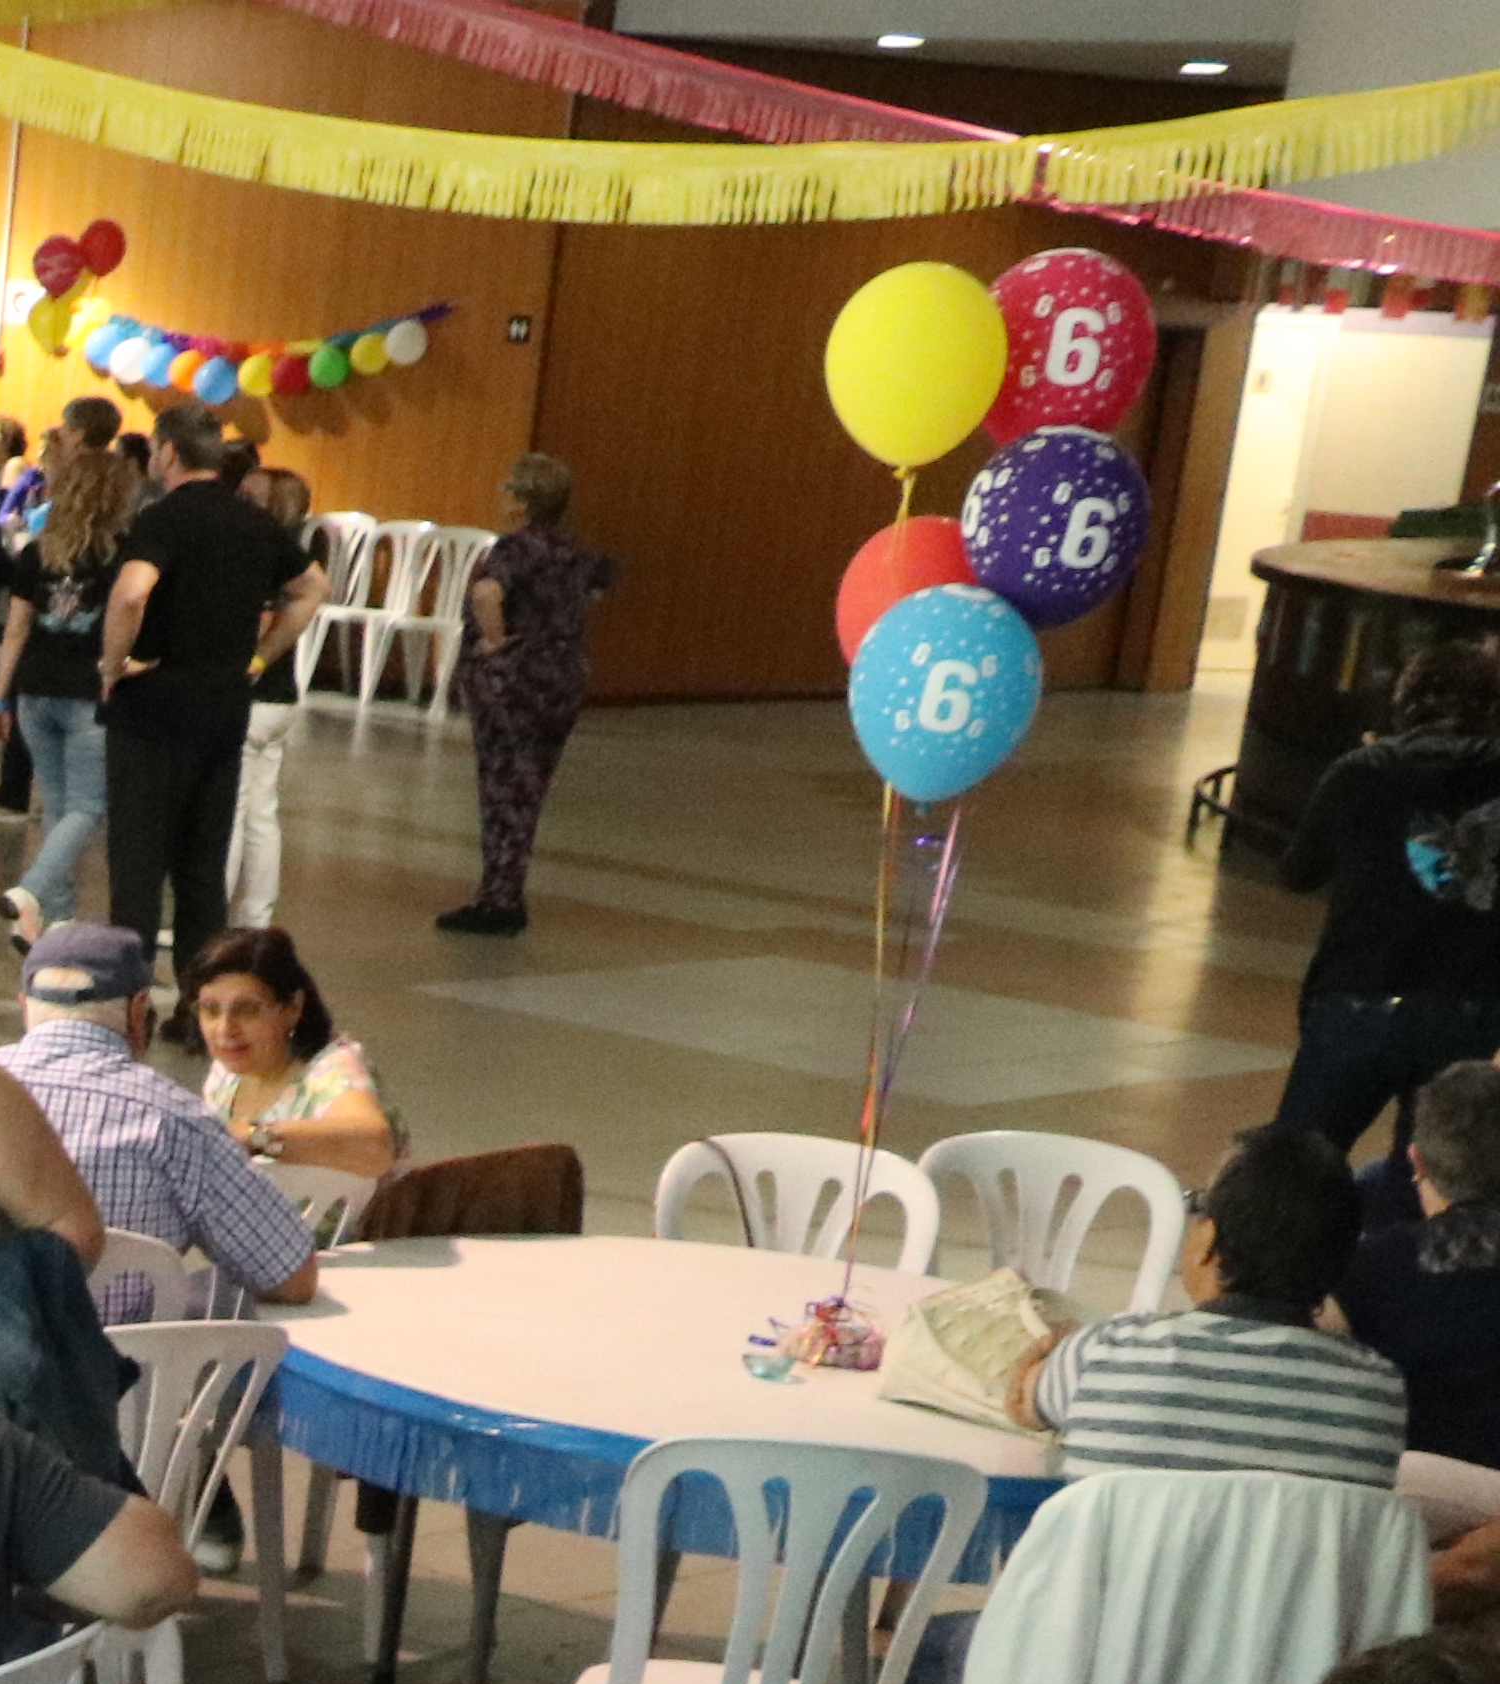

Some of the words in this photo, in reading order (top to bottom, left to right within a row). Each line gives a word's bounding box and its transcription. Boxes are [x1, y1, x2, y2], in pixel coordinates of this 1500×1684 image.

[1045, 306, 1106, 387] 6
[961, 468, 994, 540] 6
[1058, 496, 1118, 571] 6
[918, 659, 980, 734] 6
